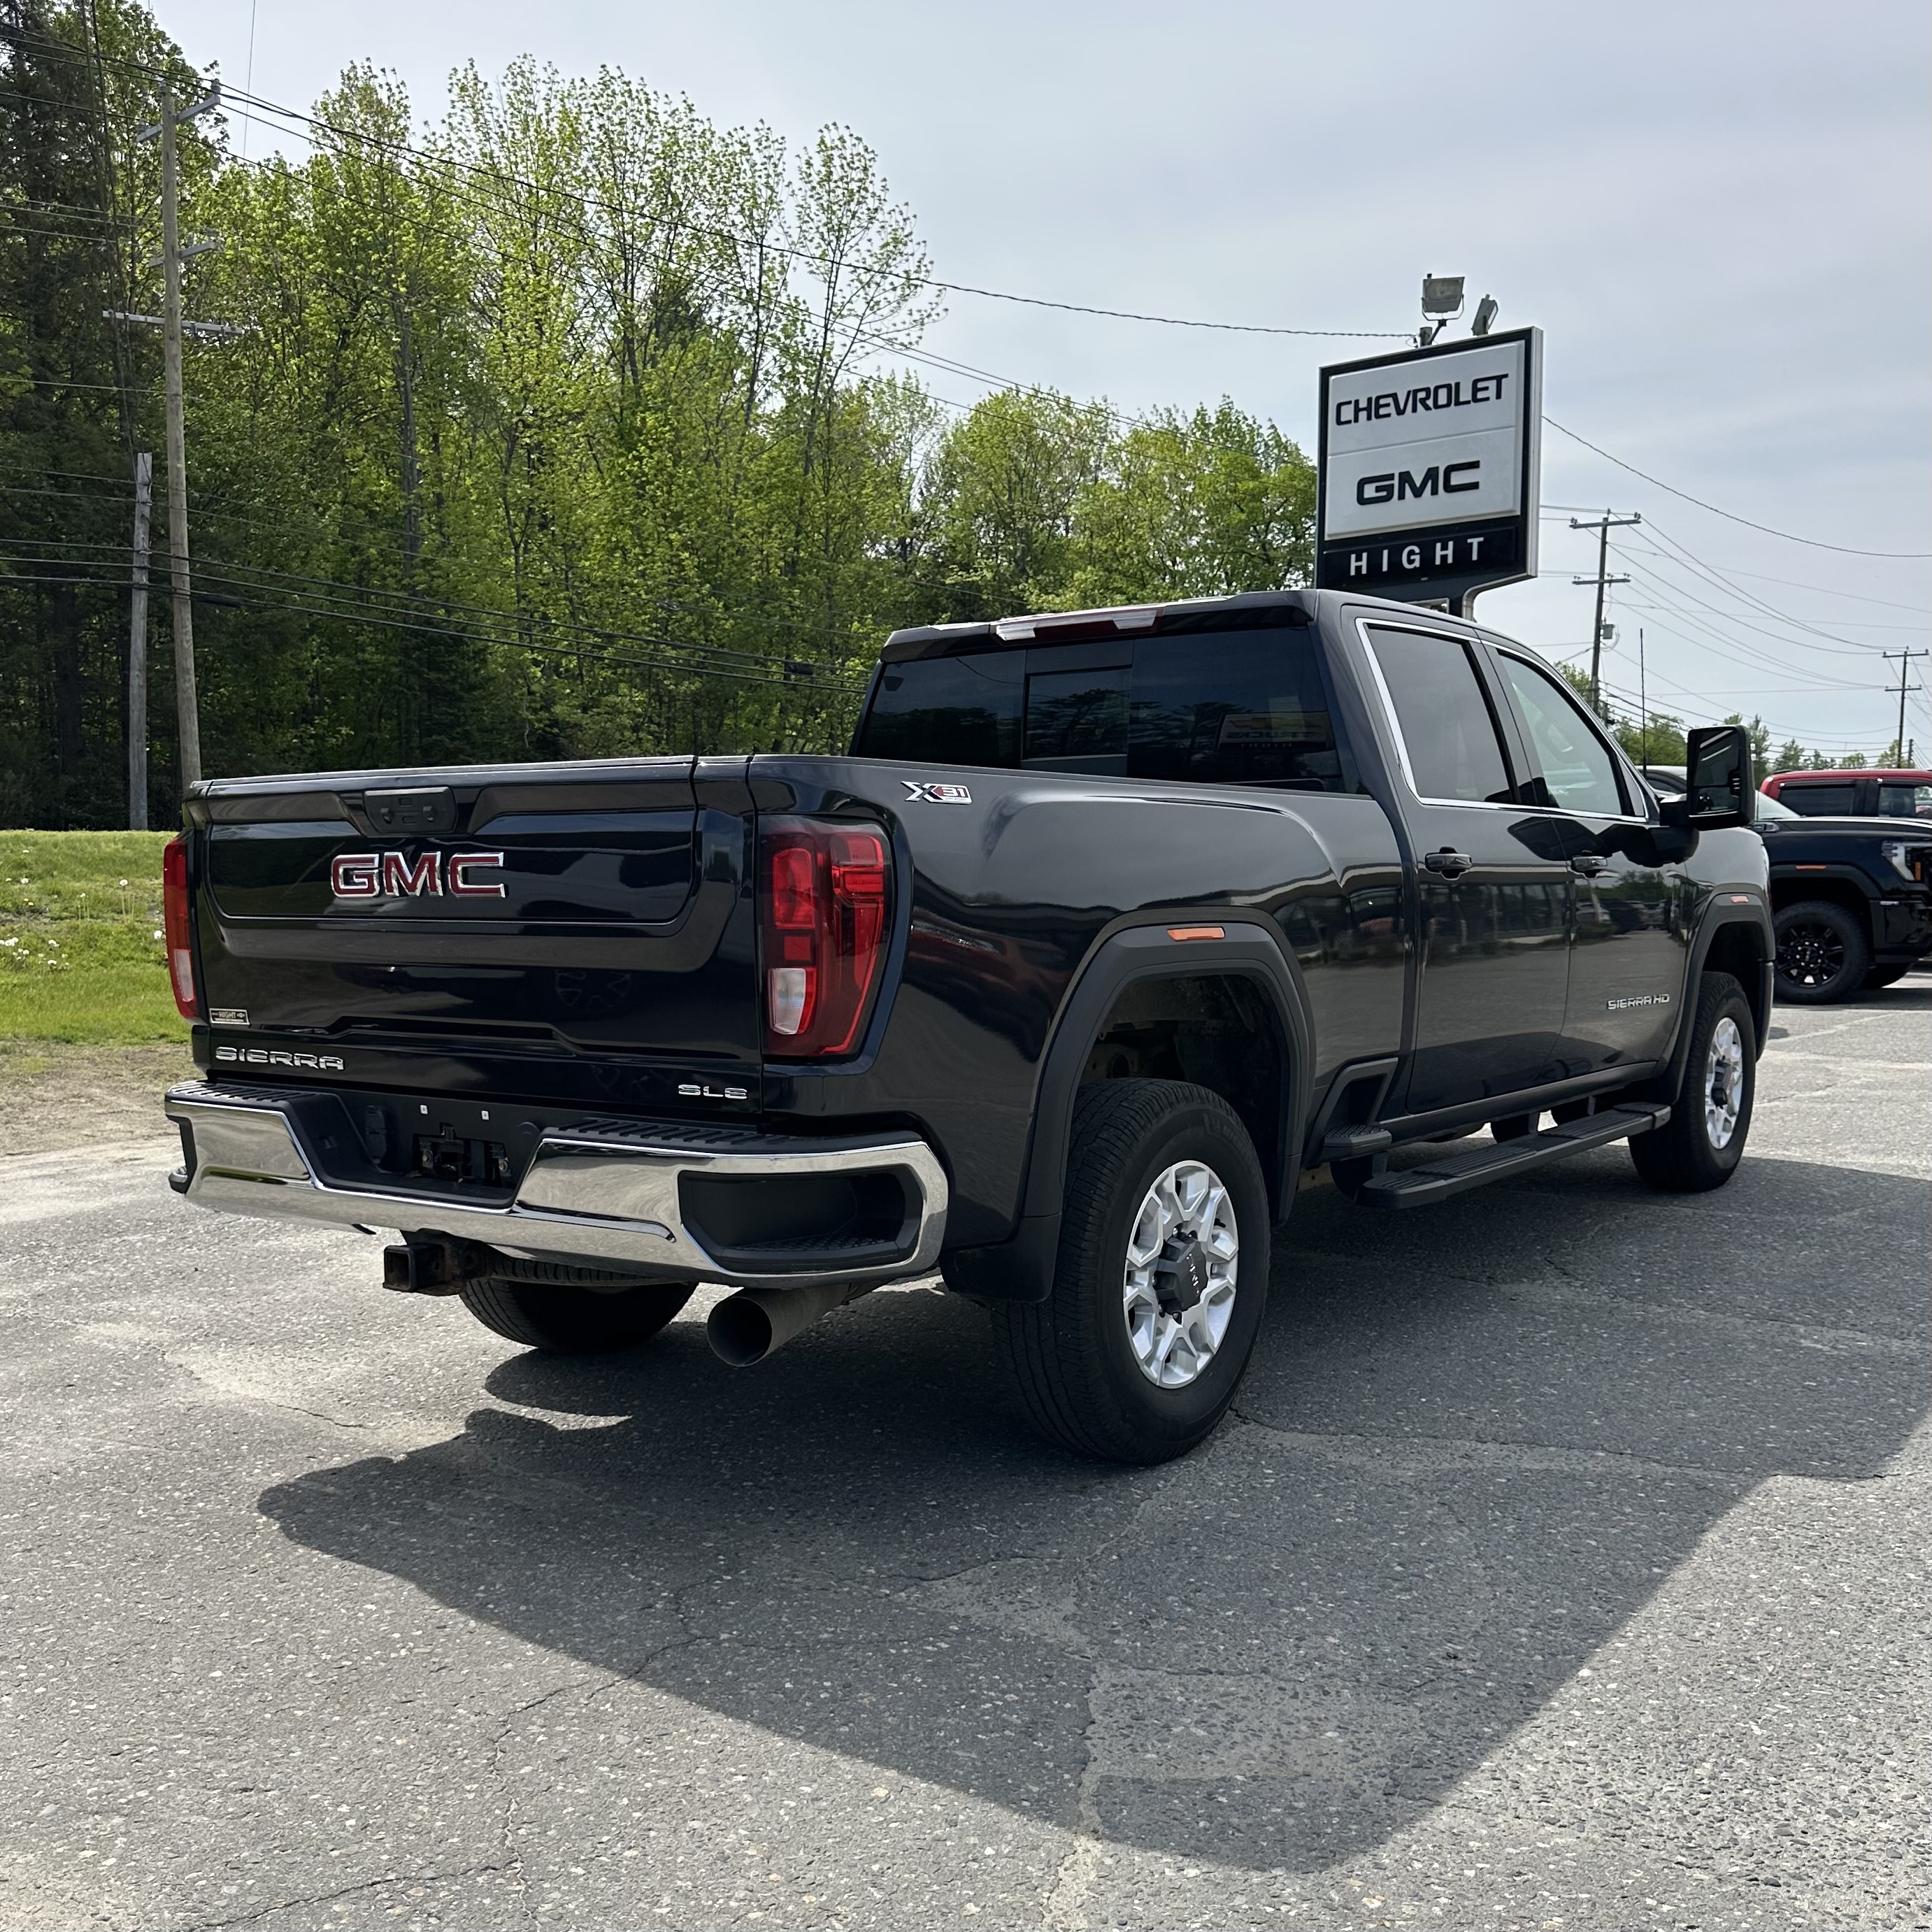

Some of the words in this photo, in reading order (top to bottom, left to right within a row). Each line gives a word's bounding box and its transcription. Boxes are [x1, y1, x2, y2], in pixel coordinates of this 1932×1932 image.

[1336, 373, 1509, 426] CHEVROLET
[1357, 460, 1481, 506] GMC
[1350, 537, 1484, 576] HIGHT
[331, 851, 506, 899] GMC
[1608, 996, 1652, 1010] SIERRA
[1653, 994, 1670, 1004] HD
[215, 1047, 344, 1071] SIERRA
[678, 1085, 747, 1099] SLE
